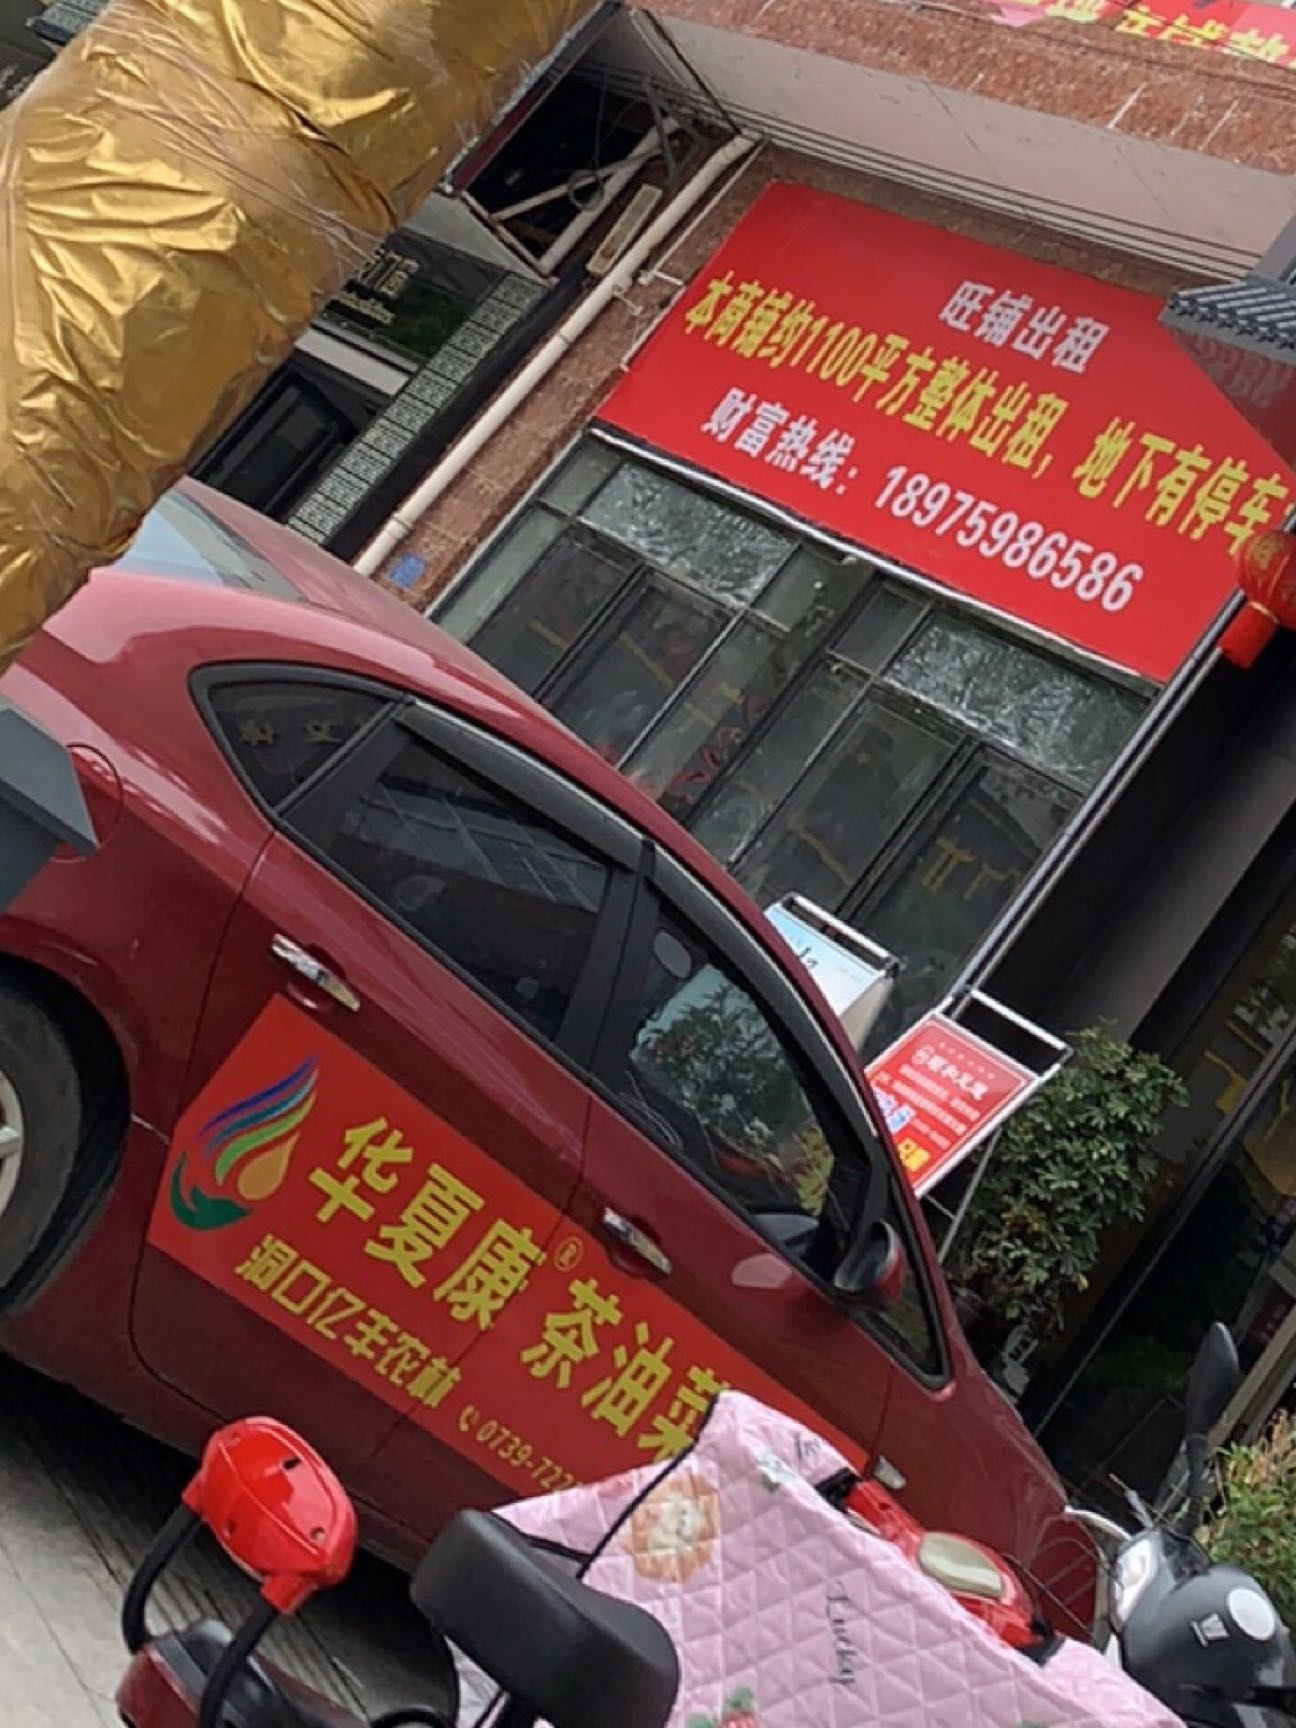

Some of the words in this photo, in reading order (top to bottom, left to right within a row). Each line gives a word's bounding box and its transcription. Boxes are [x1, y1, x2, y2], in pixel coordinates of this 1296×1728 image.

[681, 270, 1292, 556] 本商铺约1100平方整体出租，地下有停车
[938, 278, 1110, 376] 旺铺出租
[308, 1116, 547, 1331] 华夏康
